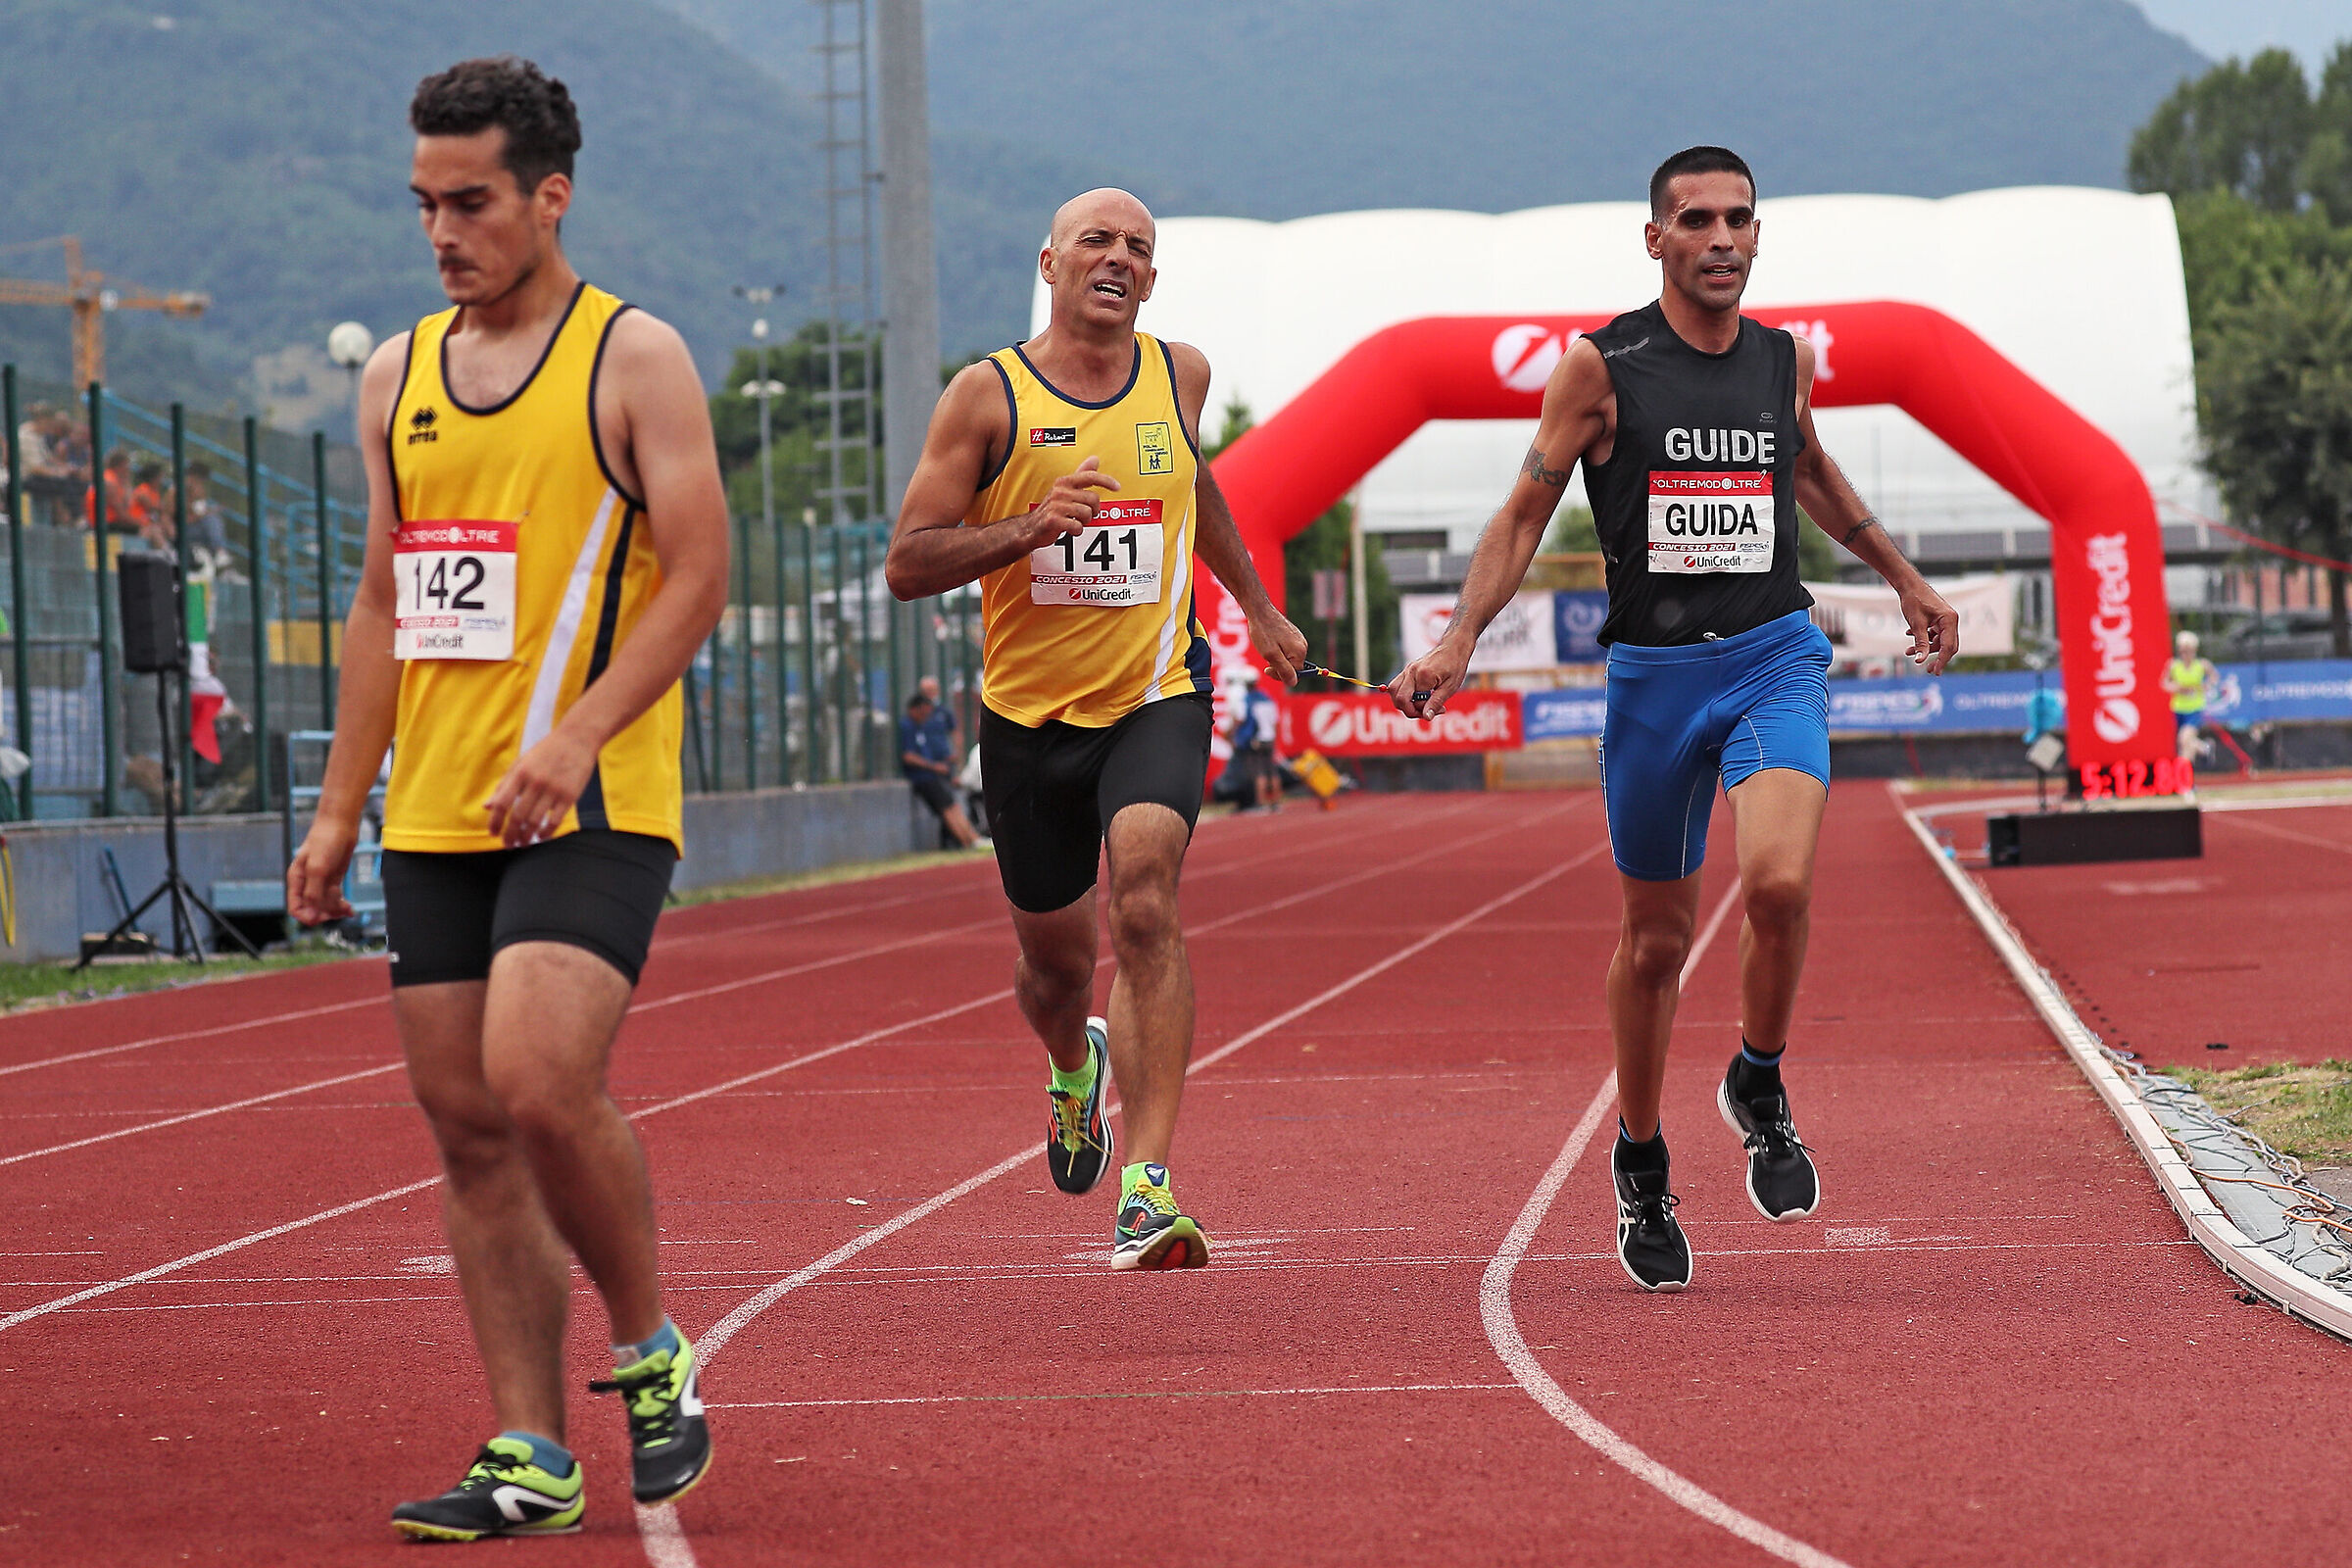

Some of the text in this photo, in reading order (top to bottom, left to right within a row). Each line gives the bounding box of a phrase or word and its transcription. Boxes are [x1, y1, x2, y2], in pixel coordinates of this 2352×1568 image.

[1665, 428, 1775, 464] GUIDE
[1665, 503, 1758, 536] GUIDA
[1054, 528, 1137, 572] 141
[1696, 555, 1741, 567] UniCredit
[416, 557, 484, 610] 142
[1036, 575, 1094, 584] CONCESIO
[1096, 575, 1125, 584] 2021
[1082, 588, 1132, 601] UniCredit
[2086, 531, 2136, 698] UniCredit
